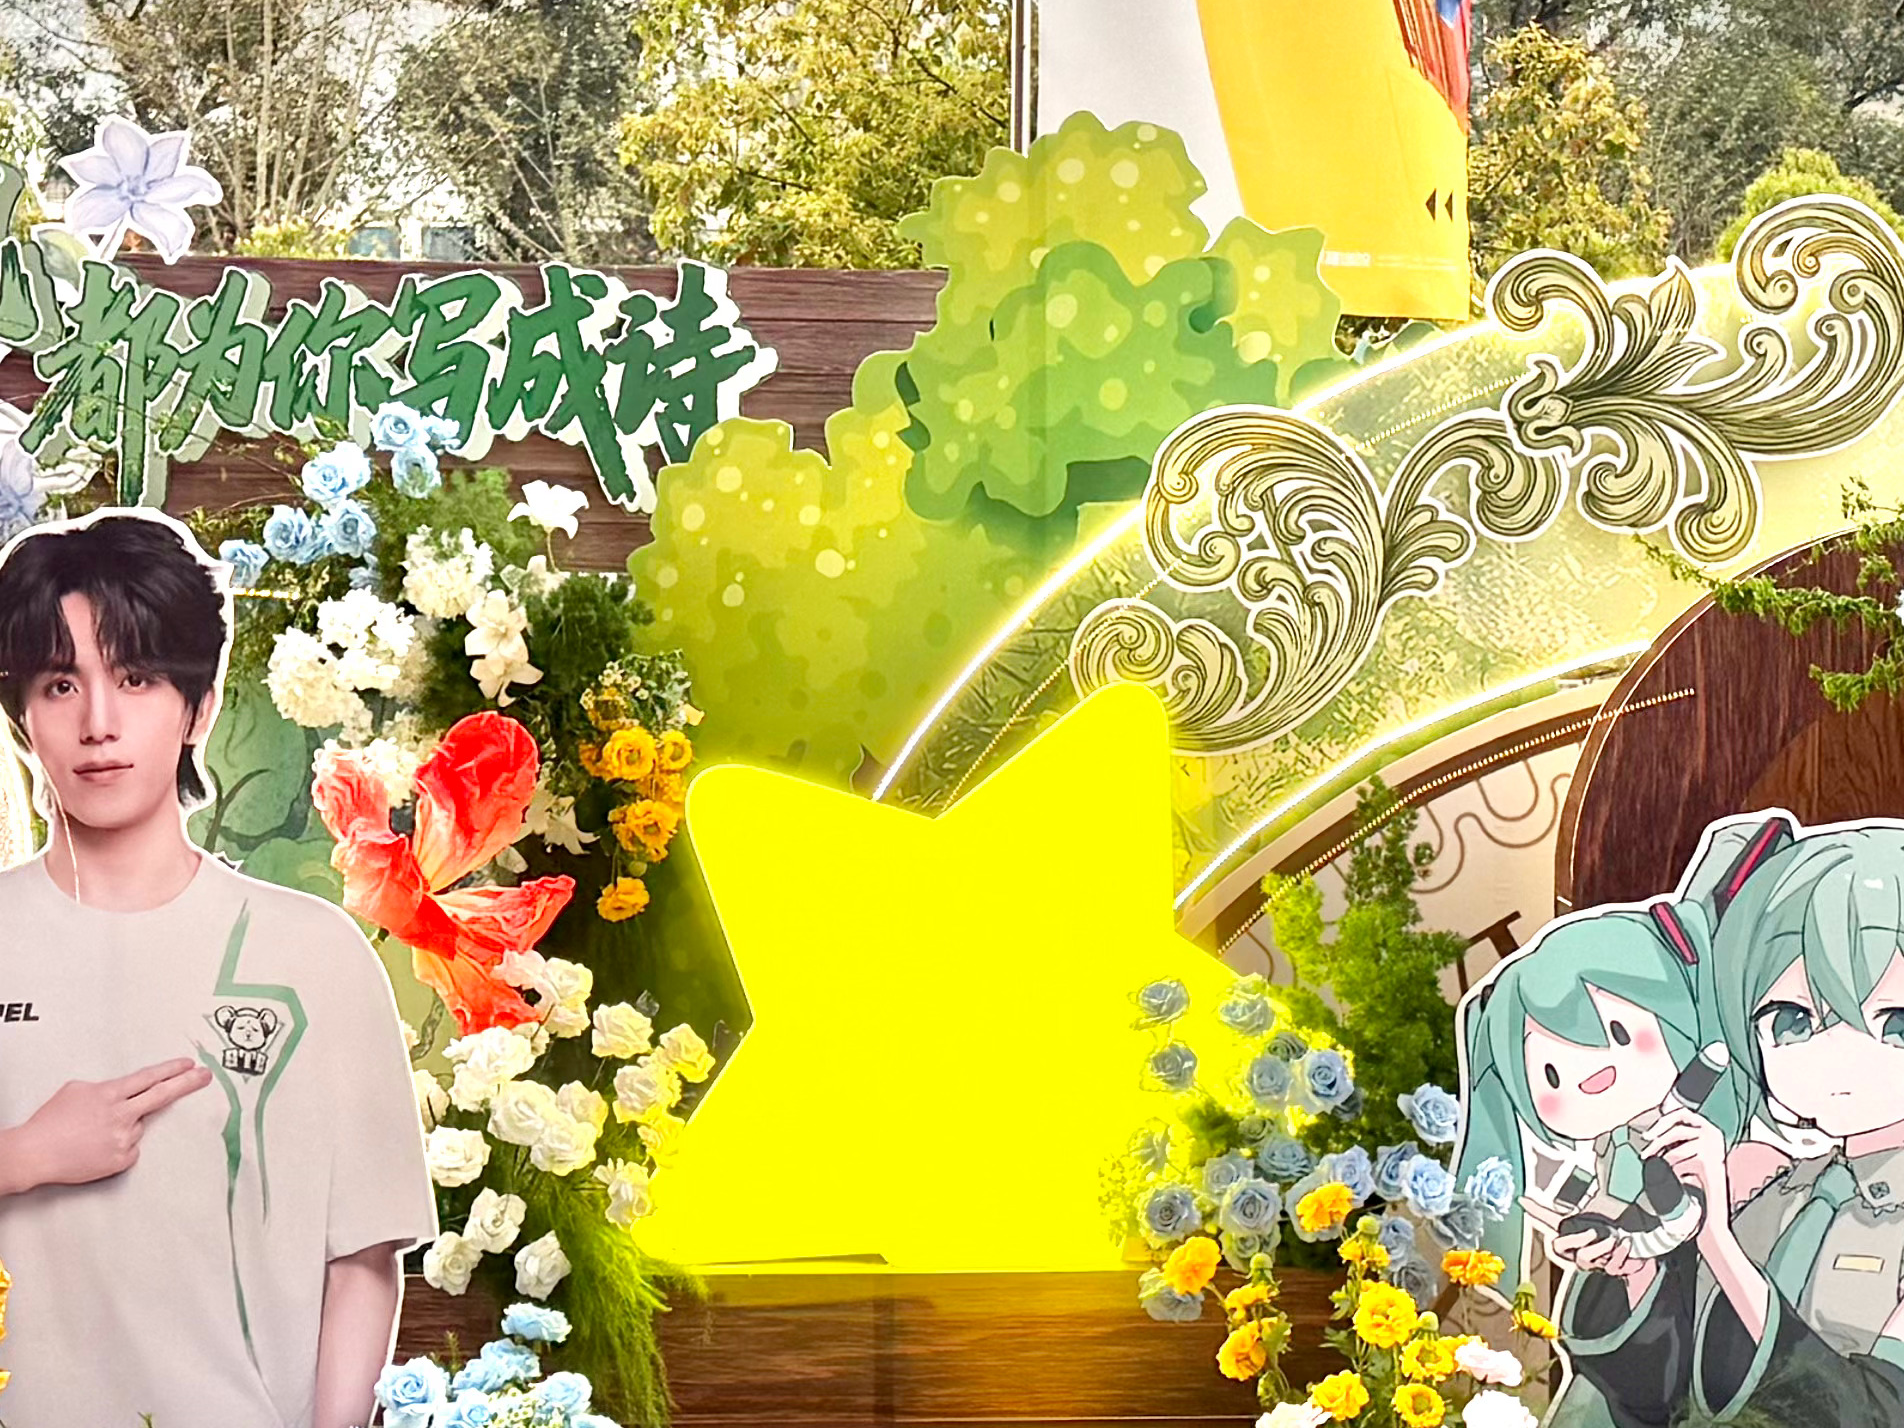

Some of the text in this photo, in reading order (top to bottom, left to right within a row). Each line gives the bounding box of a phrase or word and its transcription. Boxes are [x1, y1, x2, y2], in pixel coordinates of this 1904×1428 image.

[18, 259, 760, 508] 都为你写成诗
